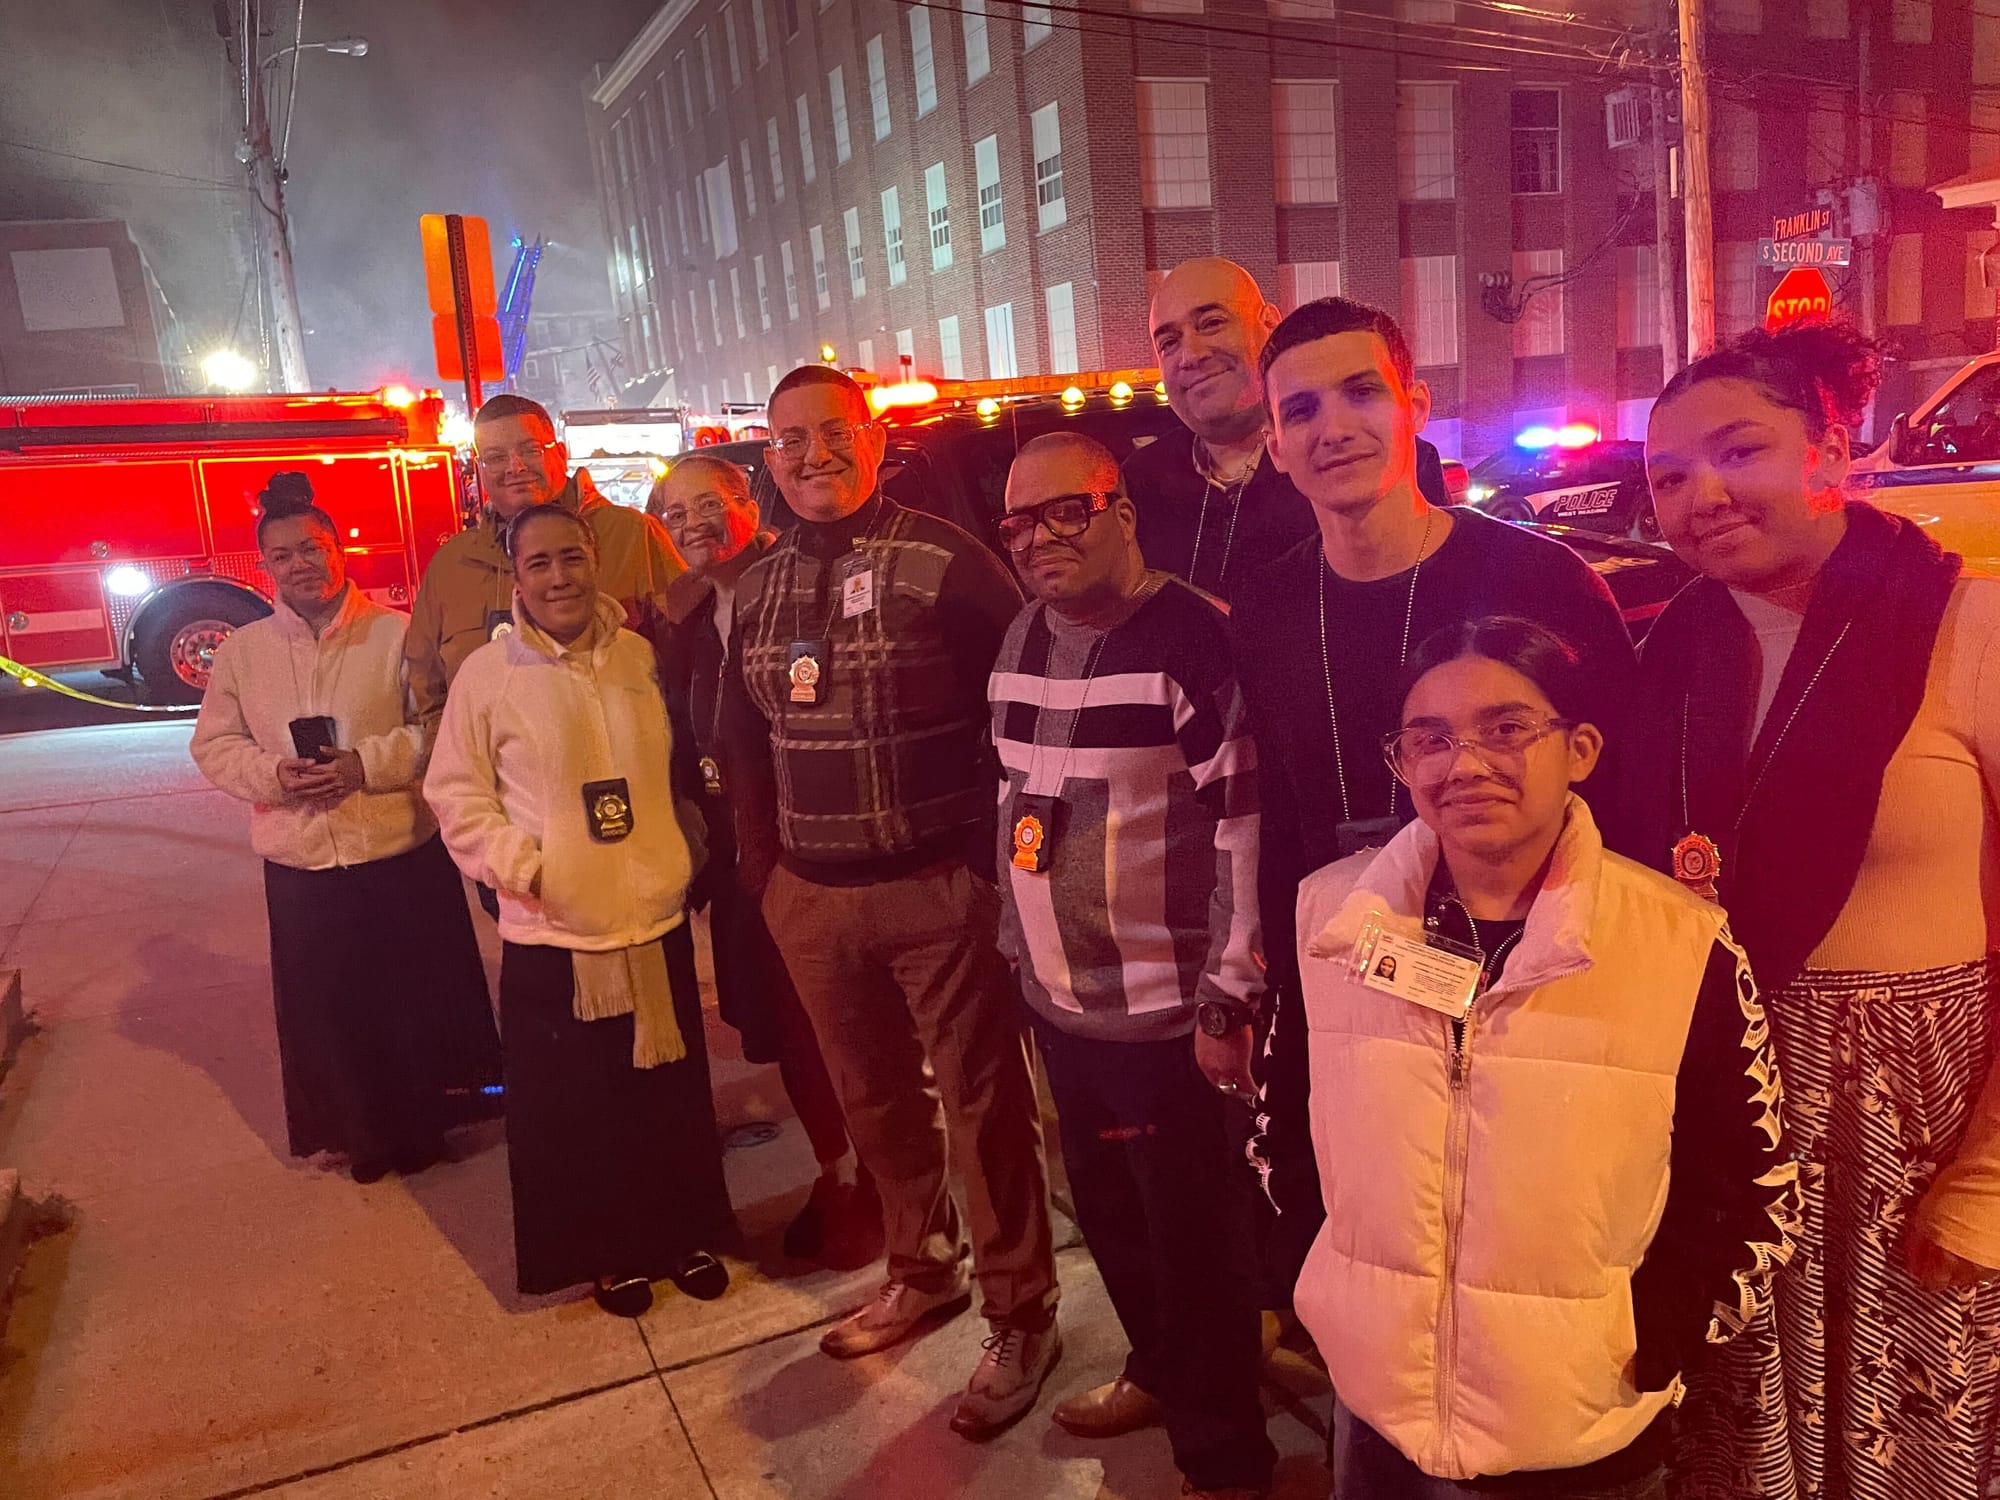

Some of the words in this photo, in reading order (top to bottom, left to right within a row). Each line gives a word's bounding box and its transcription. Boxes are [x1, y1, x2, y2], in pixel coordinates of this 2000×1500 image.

[1774, 209, 1820, 241] FRANKLIN
[1821, 210, 1830, 226] ST
[1762, 245, 1769, 260] S
[1772, 242, 1823, 263] SECOND
[1826, 245, 1845, 260] AVE
[1773, 297, 1826, 319] STOP
[1553, 489, 1618, 512] POLICE
